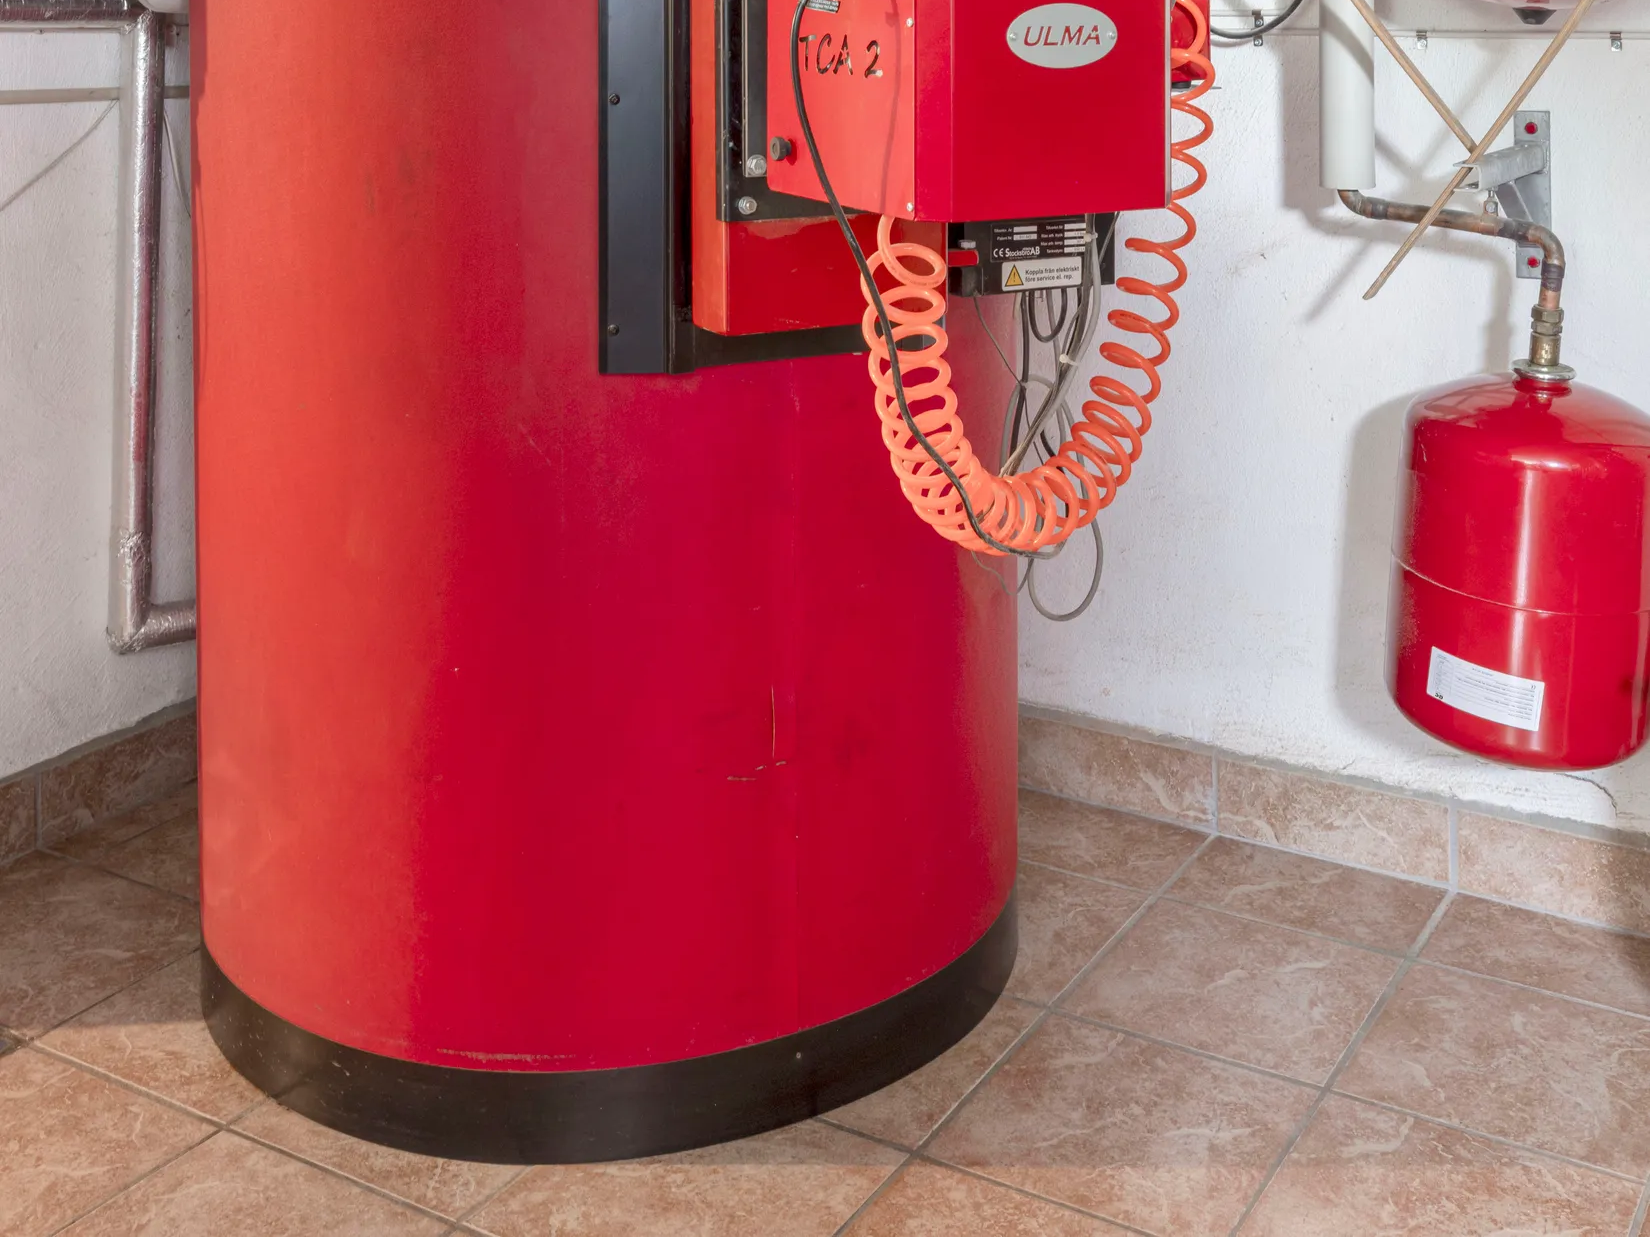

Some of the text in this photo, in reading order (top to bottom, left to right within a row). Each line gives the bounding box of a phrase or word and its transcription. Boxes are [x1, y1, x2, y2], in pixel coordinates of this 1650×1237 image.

[1024, 25, 1100, 46] ULMA
[799, 33, 883, 78] TCA 2
